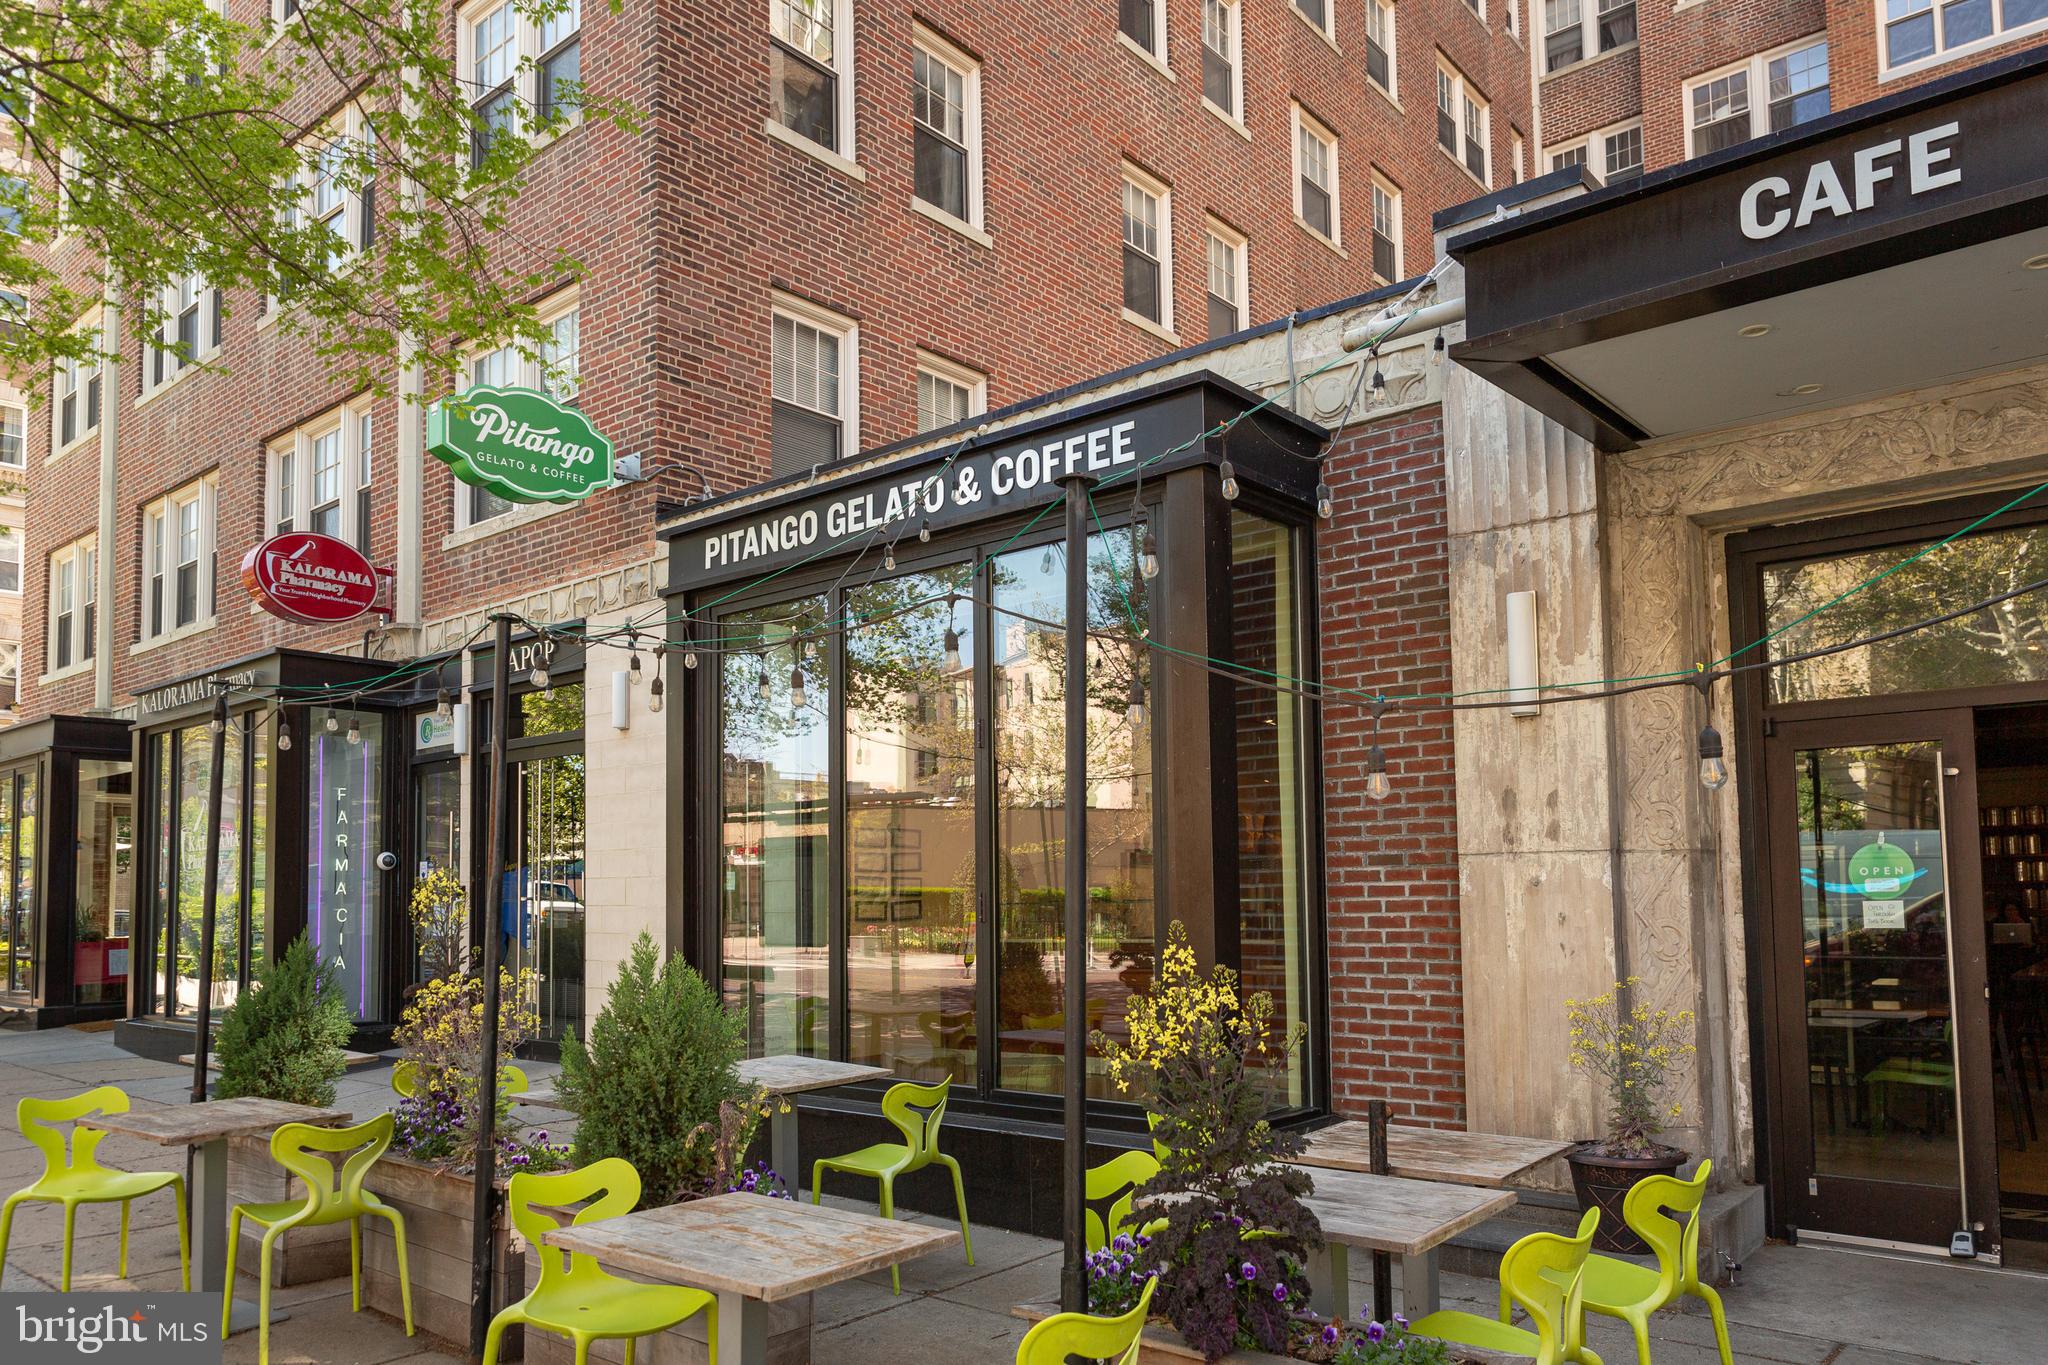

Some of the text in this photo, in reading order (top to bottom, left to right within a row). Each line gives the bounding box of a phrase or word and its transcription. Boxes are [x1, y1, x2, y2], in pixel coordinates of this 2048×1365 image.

[1740, 121, 1961, 240] CAFE
[470, 403, 595, 469] Pitango
[477, 451, 585, 484] GELATO & COFFEE
[705, 420, 1136, 570] PITANGO GELATO & COFFEE
[280, 571, 347, 596] Pharmacy
[281, 559, 373, 587] KALORAMA
[309, 592, 344, 603] Neighborhood
[344, 597, 366, 607] Pharmacy
[142, 679, 205, 714] KALORAMA
[334, 788, 349, 969] FARMACIA
[1859, 866, 1904, 876] OPEN
